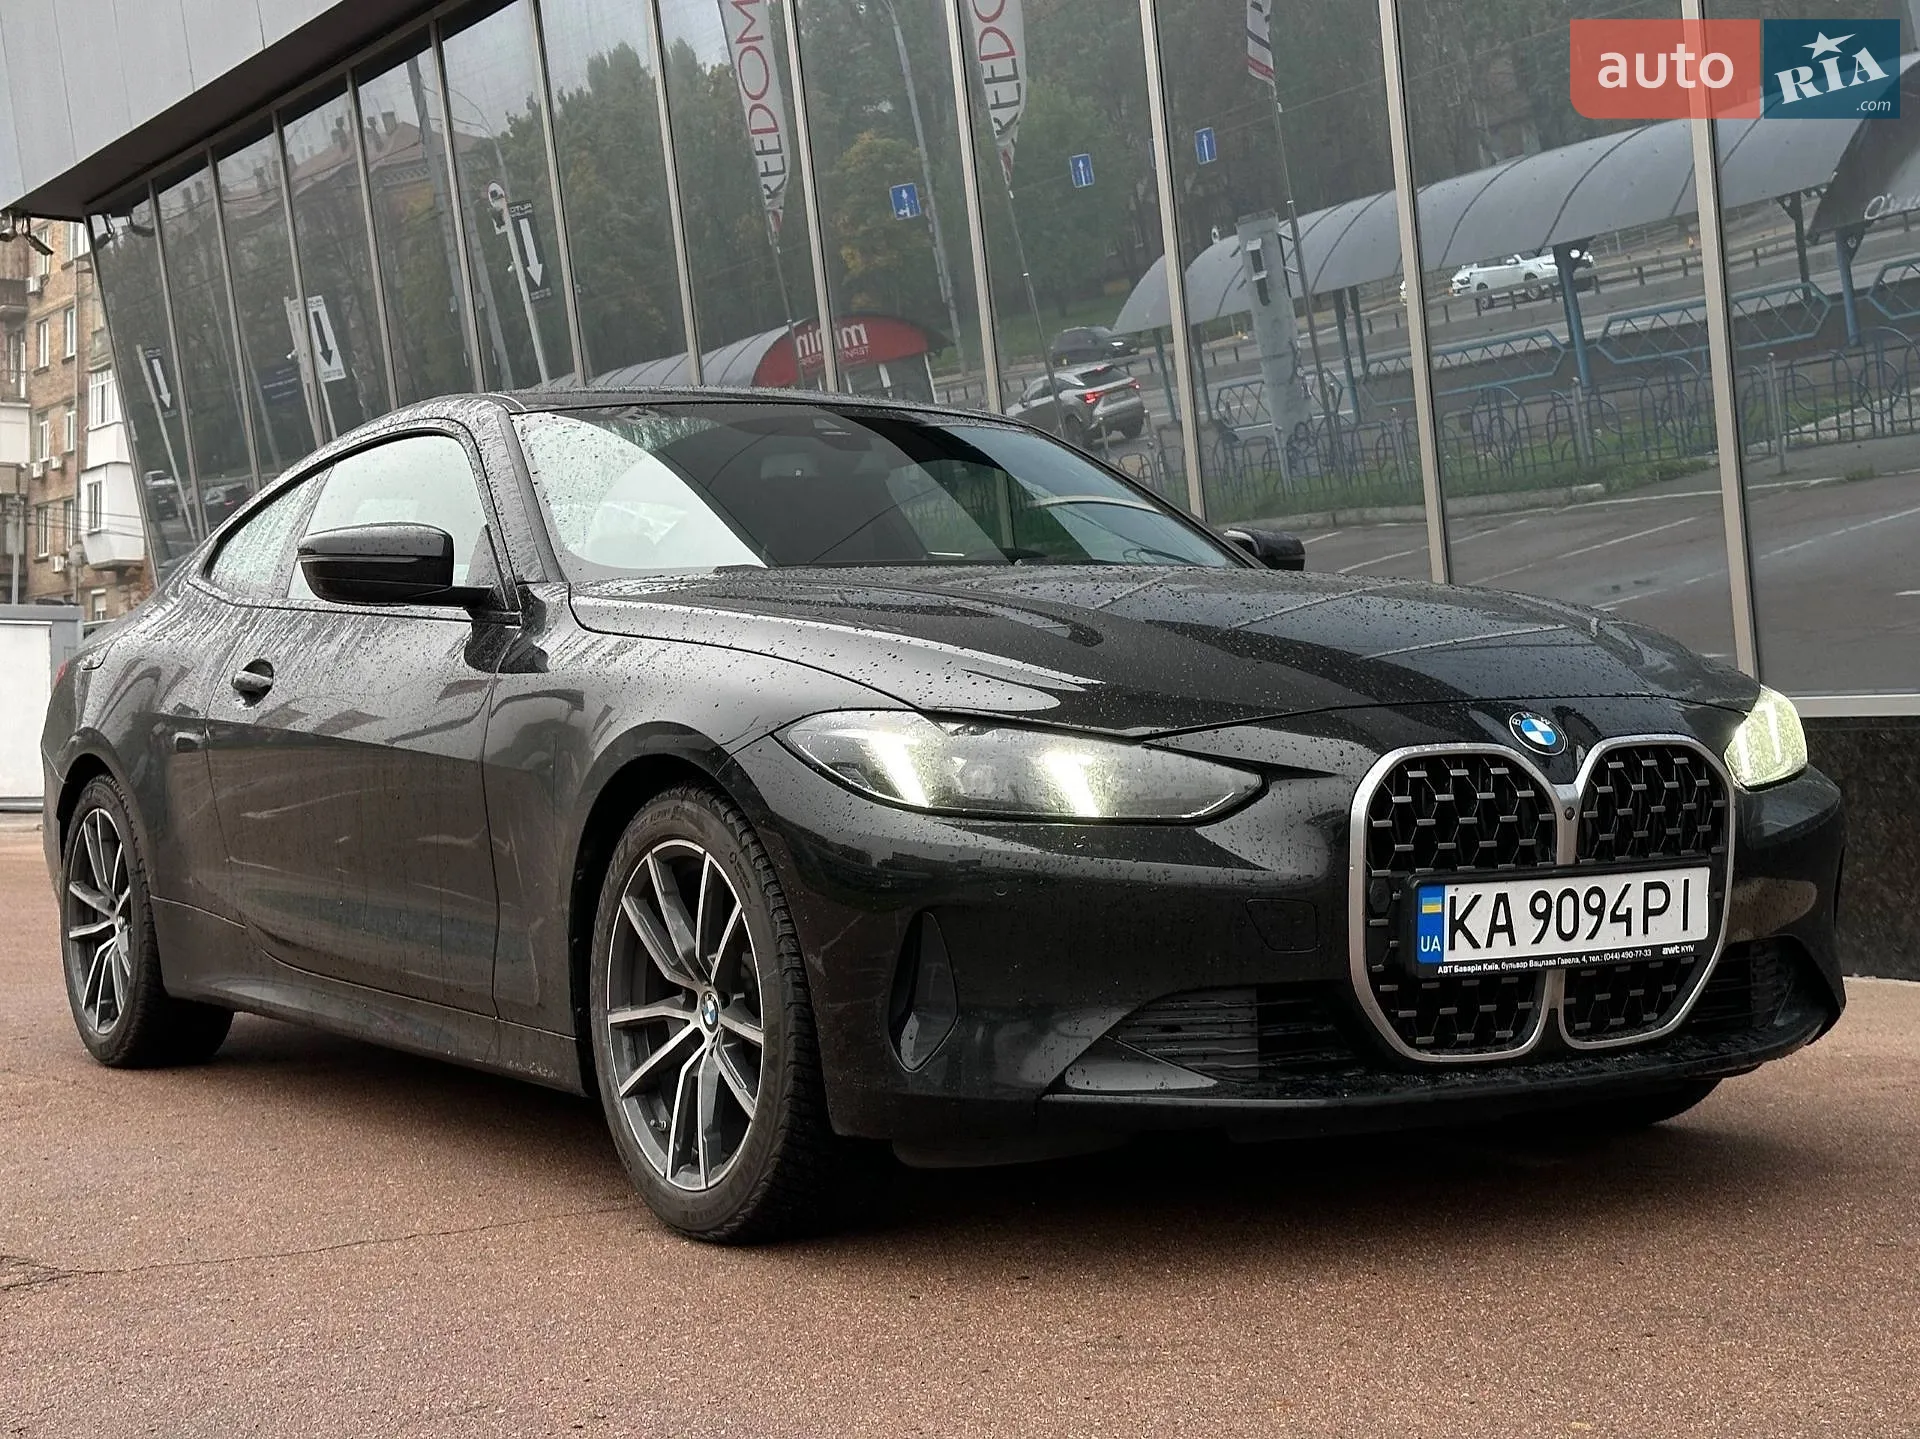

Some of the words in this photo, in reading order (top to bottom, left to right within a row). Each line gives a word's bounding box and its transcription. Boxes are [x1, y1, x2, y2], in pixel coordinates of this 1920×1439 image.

[731, 0, 787, 206] REEDOM
[1448, 892, 1517, 951] KA
[1528, 882, 1633, 946] 9094
[1420, 935, 1442, 952] UA
[1453, 964, 1482, 974] Баварія
[1501, 960, 1528, 971] бульвар
[1529, 959, 1556, 968] Вацлава
[1603, 951, 1621, 962] (044)
[1621, 948, 1652, 959] 490-77-33
